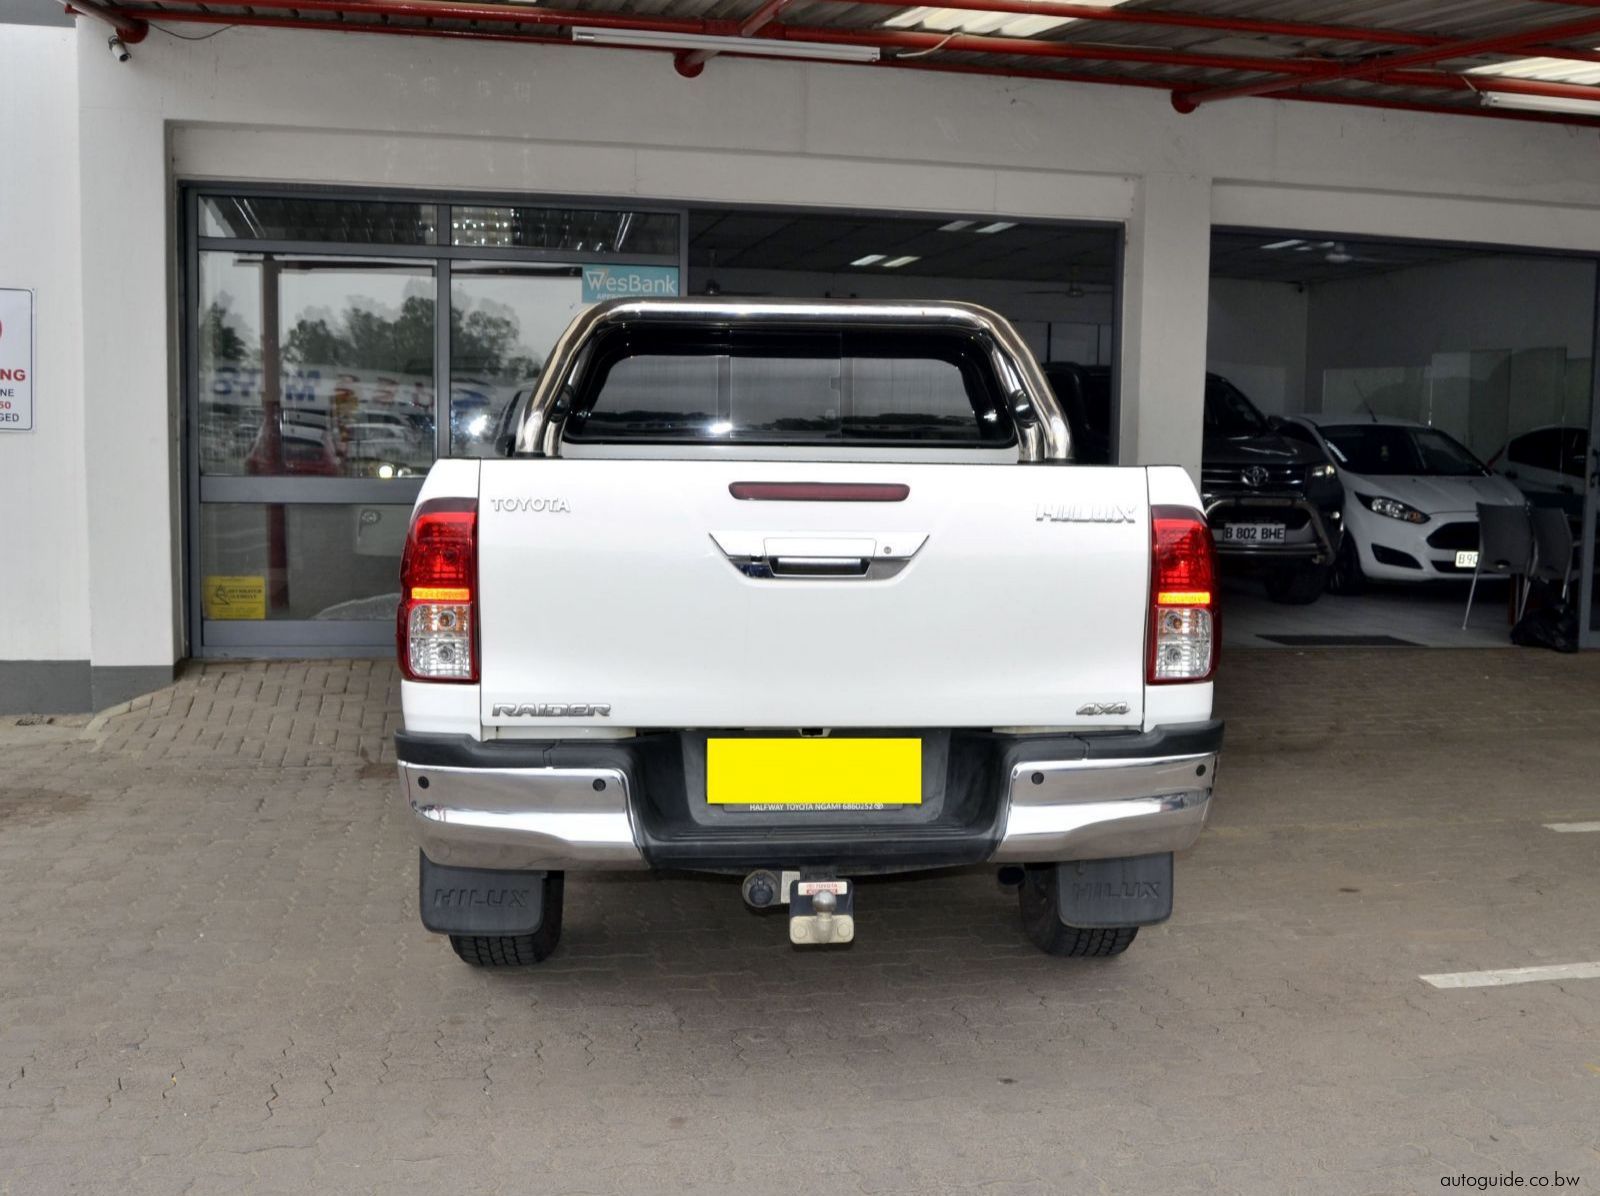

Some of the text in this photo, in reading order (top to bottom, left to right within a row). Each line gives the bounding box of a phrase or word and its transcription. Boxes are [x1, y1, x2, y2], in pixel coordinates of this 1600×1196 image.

[585, 271, 676, 293] WesBank
[490, 497, 571, 513] TOYOTA
[1225, 527, 1285, 540] B 802 BHE
[492, 703, 611, 717] RAIDER
[749, 803, 783, 811] HALFWAY
[786, 803, 814, 811] TOYOTA
[815, 802, 841, 810] NGAMI
[432, 888, 530, 907] HILUX
[1071, 881, 1161, 901] HILUX
